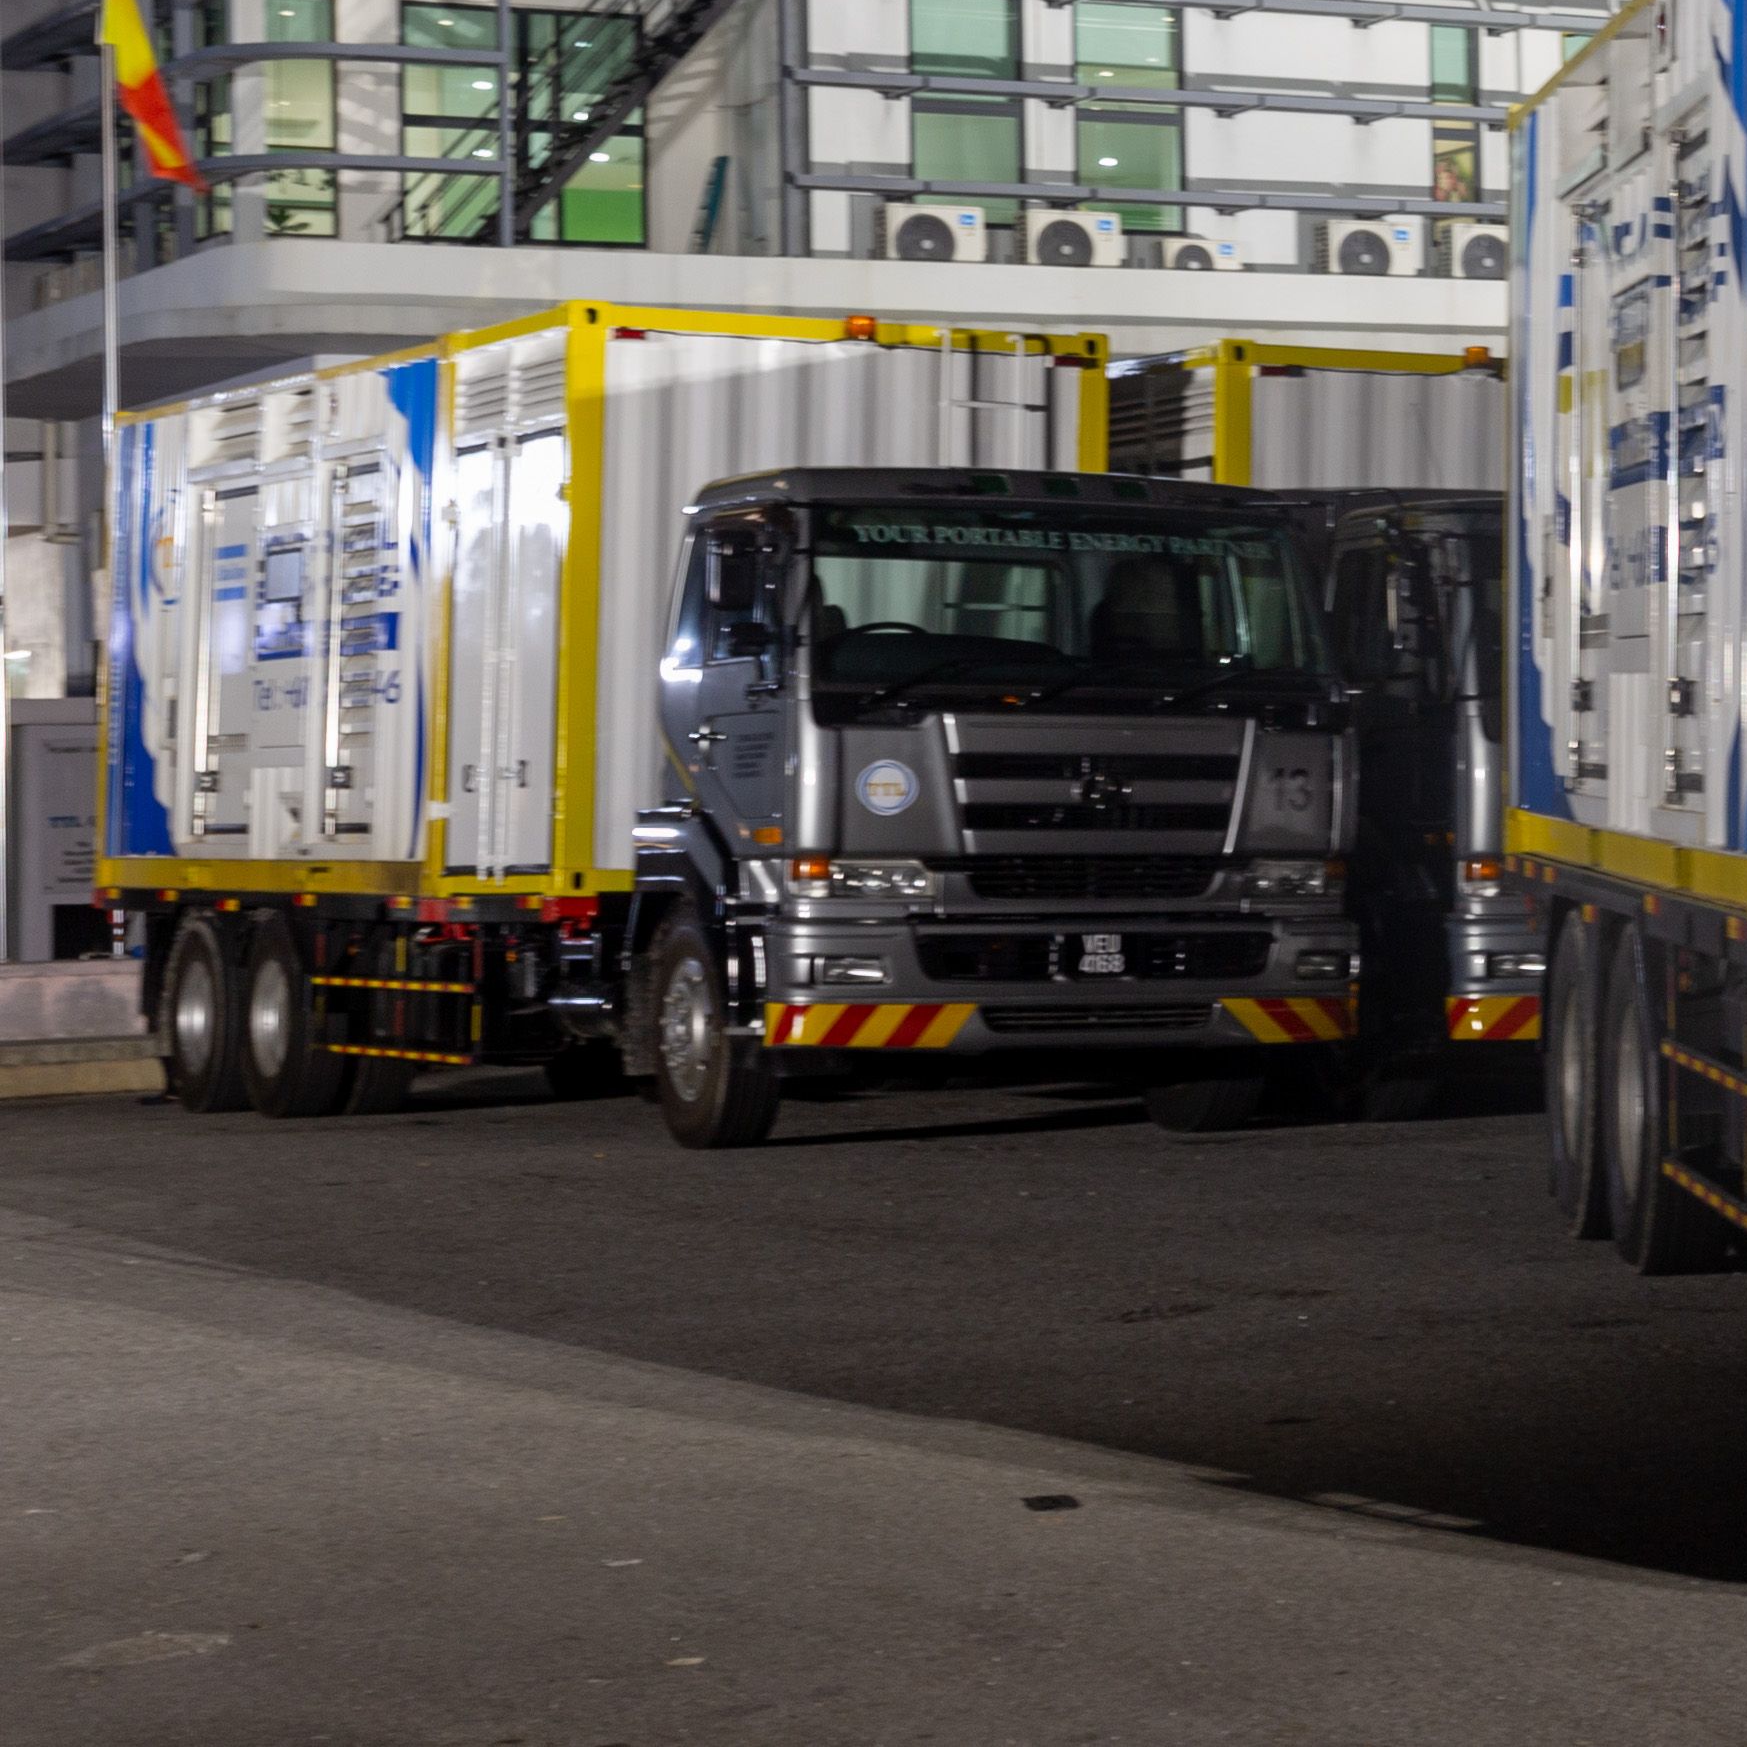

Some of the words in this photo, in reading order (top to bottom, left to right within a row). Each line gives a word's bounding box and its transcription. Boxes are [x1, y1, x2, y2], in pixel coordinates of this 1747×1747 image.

[853, 525, 928, 544] YOUR
[932, 527, 1065, 550] PORTABLE
[1068, 532, 1163, 553] ENERGY
[1269, 768, 1313, 812] 13
